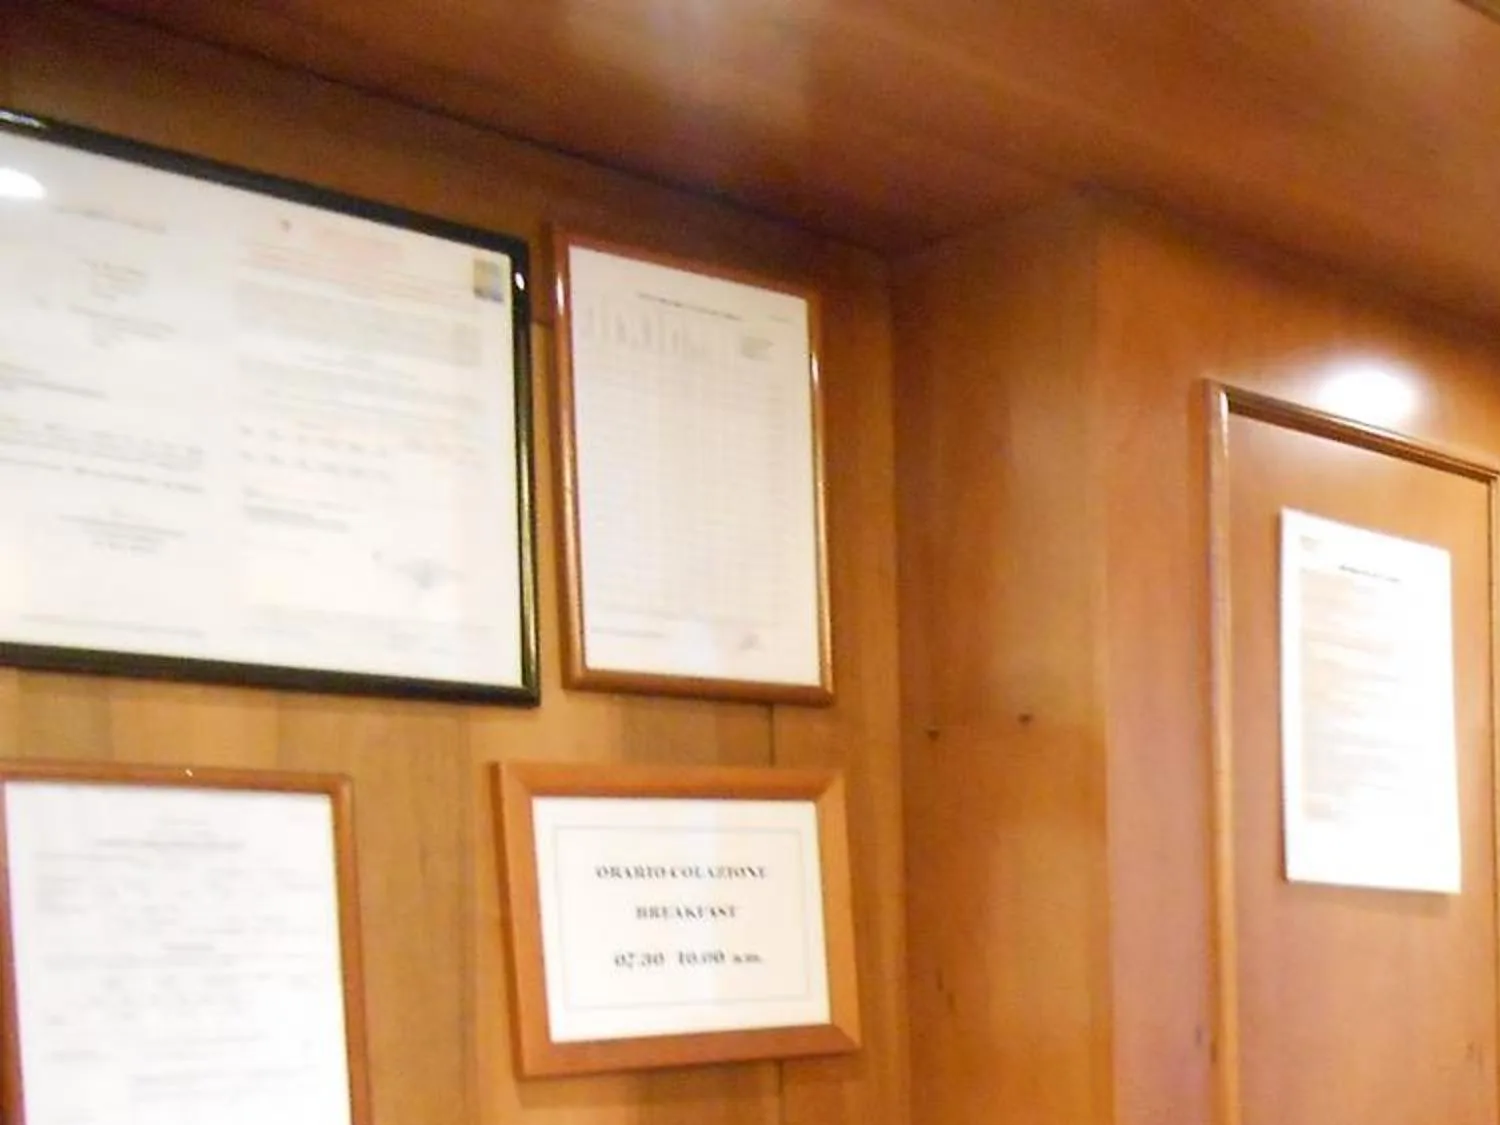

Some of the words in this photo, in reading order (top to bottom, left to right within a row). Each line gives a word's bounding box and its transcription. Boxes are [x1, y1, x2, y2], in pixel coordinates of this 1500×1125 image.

[594, 864, 667, 880] ORARIO
[670, 864, 768, 880] COLAZIONE
[635, 903, 738, 920] BREAKFAST
